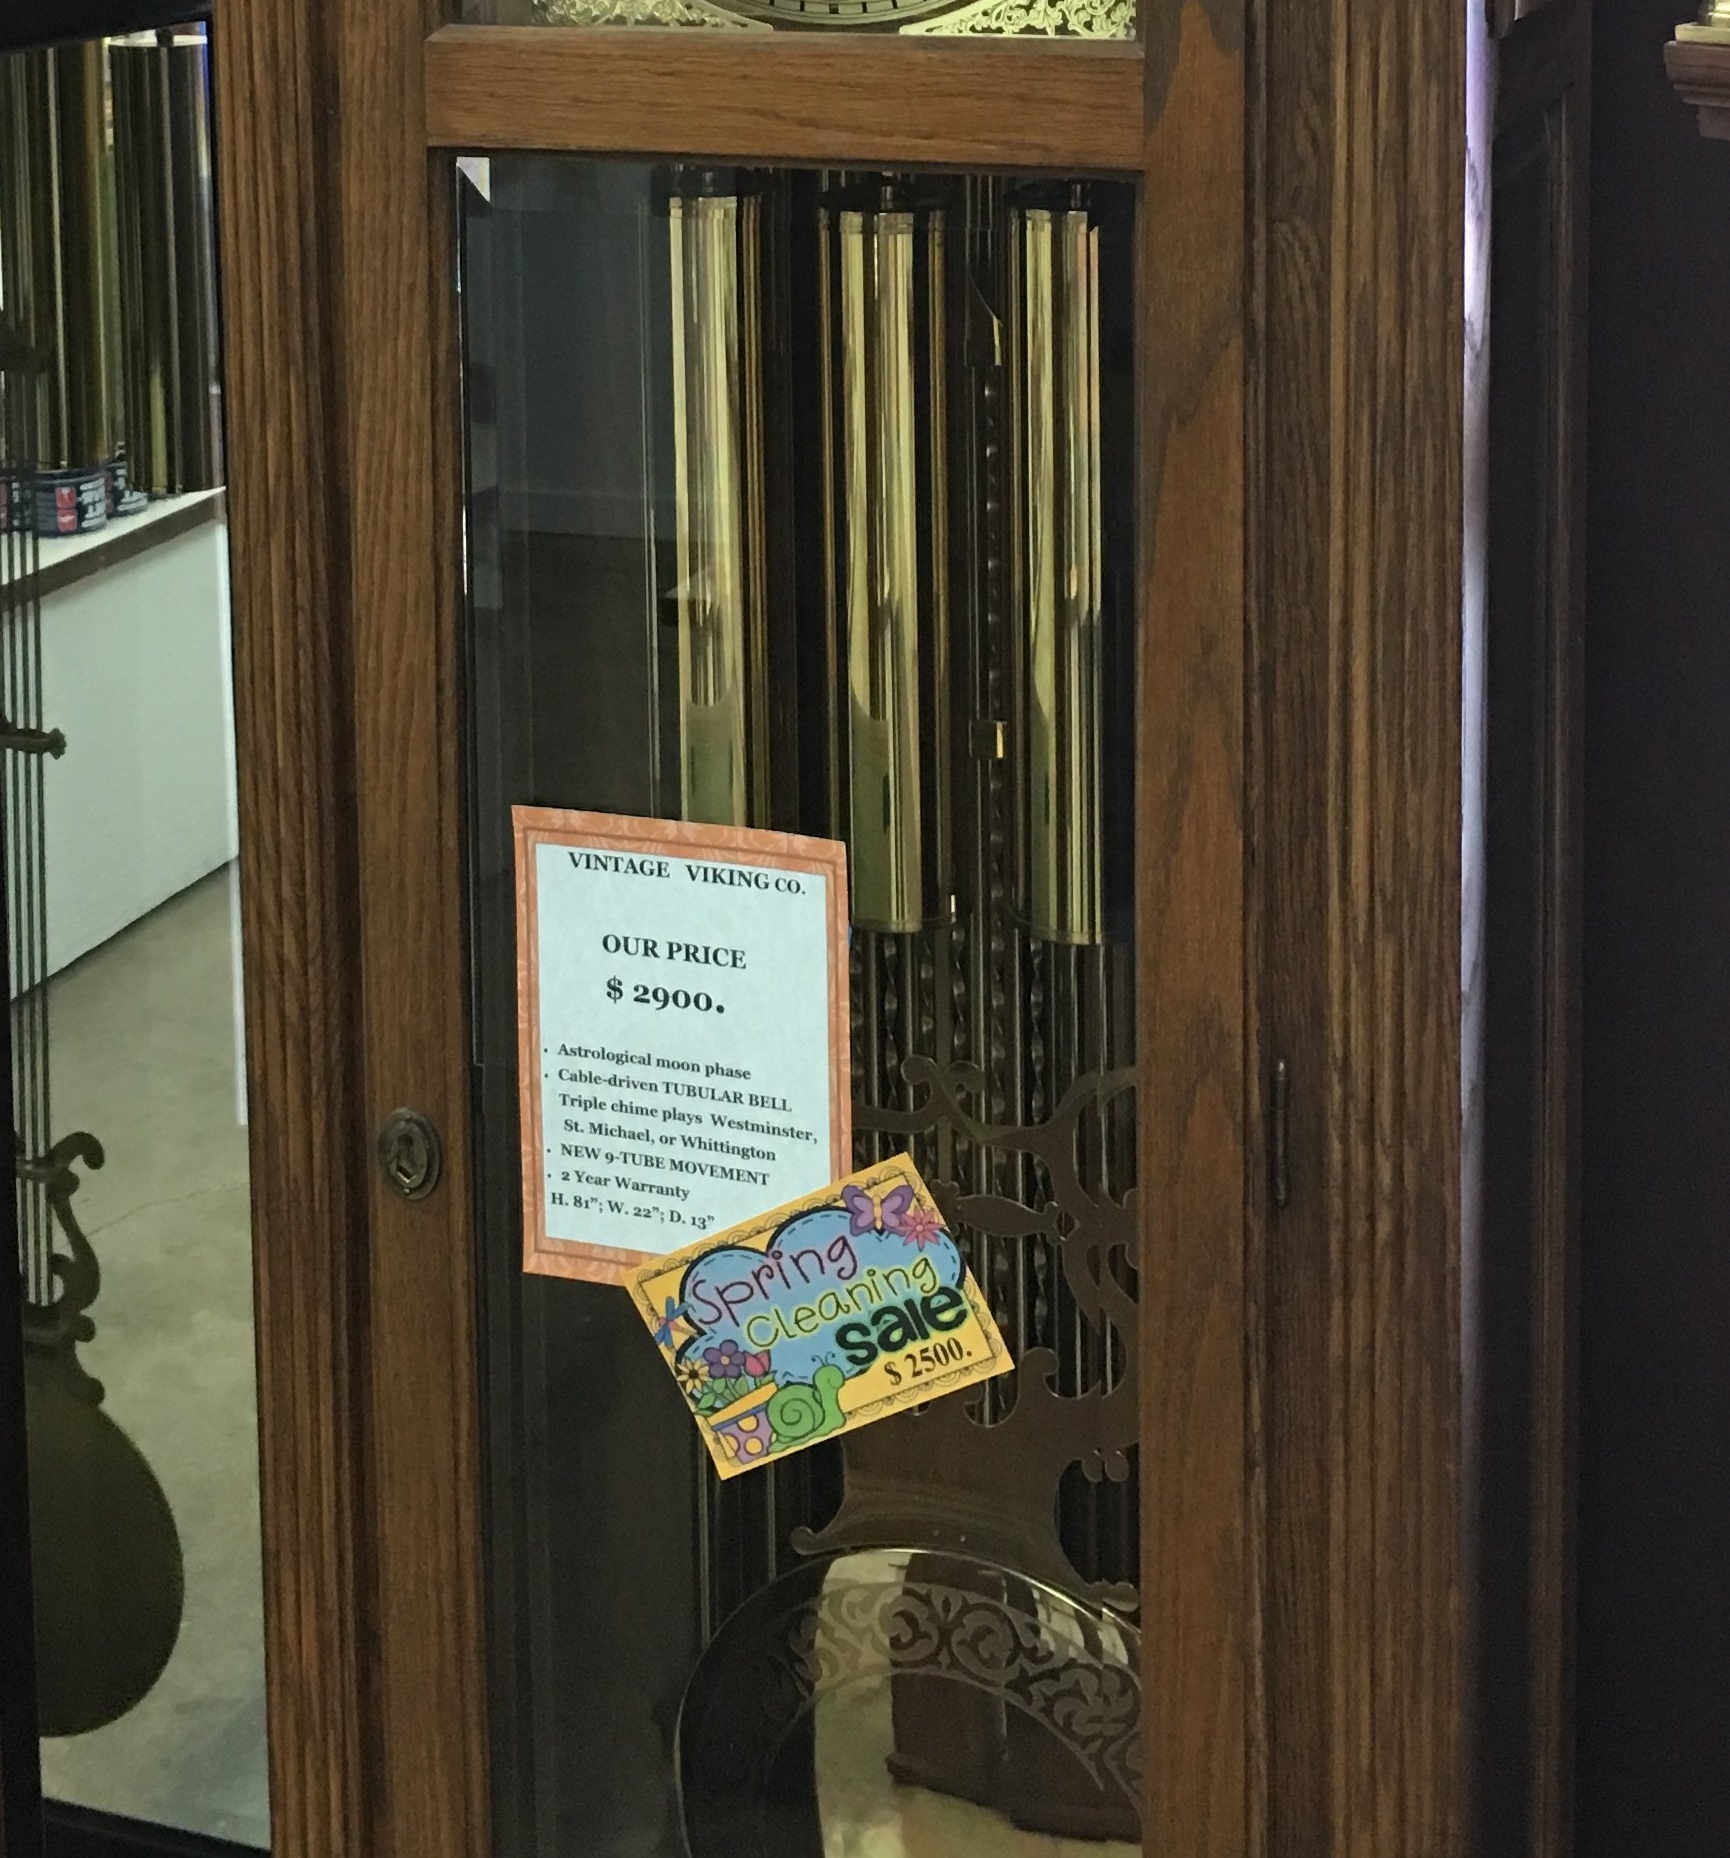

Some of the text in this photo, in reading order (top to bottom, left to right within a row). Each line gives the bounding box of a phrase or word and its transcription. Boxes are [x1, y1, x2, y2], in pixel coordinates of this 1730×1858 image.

[568, 851, 807, 896] VINTAGE VIKING CO.
[602, 933, 747, 970] OUR PRICE
[606, 975, 726, 1015] $ 2900.
[557, 1043, 752, 1081] Astrological moon phase
[558, 1068, 793, 1112] Cable-driven TUBULAR BELL
[559, 1093, 819, 1144] Triple chime plays Westminster,
[564, 1118, 777, 1162] St. Michael, or Whittington
[560, 1143, 771, 1187] NEW 9-TUBE MOVEMENT
[561, 1170, 691, 1202] 2 Year Warranty
[551, 1192, 570, 1208] H.
[607, 1200, 630, 1216] W.
[669, 1209, 687, 1225] D.
[692, 1233, 859, 1328] Spring
[746, 1256, 938, 1348] Cleaning
[835, 1285, 968, 1367] sale
[883, 1336, 973, 1387] $ 2500.
